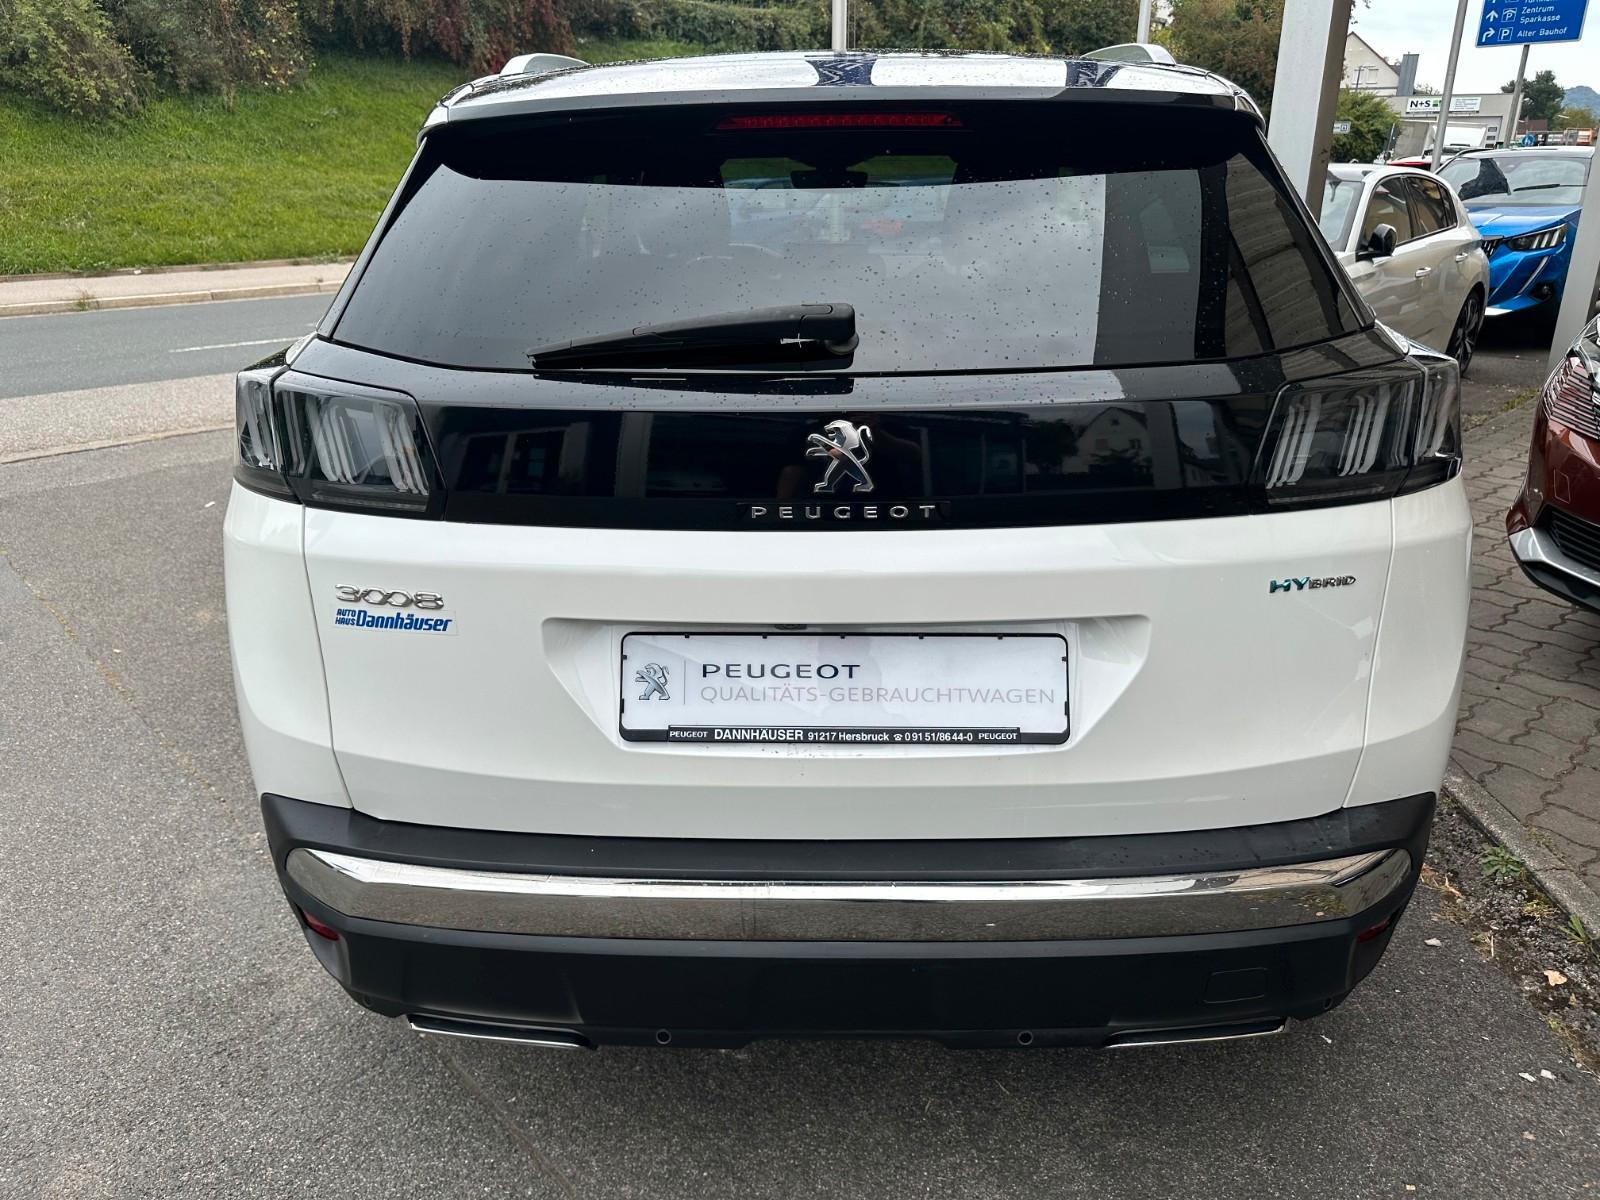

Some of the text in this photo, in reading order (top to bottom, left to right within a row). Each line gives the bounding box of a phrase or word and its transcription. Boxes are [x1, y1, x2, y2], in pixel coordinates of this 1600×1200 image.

[1521, 6, 1555, 14] Zentrum
[1519, 15, 1561, 24] Sparkasse
[1539, 27, 1568, 36] Bauhof
[751, 505, 936, 519] PEUGEOT
[1269, 575, 1357, 593] HYBRID
[335, 583, 445, 610] 3008
[336, 608, 356, 617] AUTO
[335, 616, 355, 626] HAUS
[356, 609, 453, 632] Dannhäuser
[701, 663, 860, 679] PEUGEOT
[700, 682, 1055, 704] QUALITÄTS-GEBRAUCHTWAGEN
[669, 730, 708, 738] PEUGEOT
[714, 728, 804, 741] DANNHÄUSER
[807, 732, 837, 741] 91217
[839, 732, 890, 741] Hersbruck
[978, 732, 1018, 740] PEUGEOT
